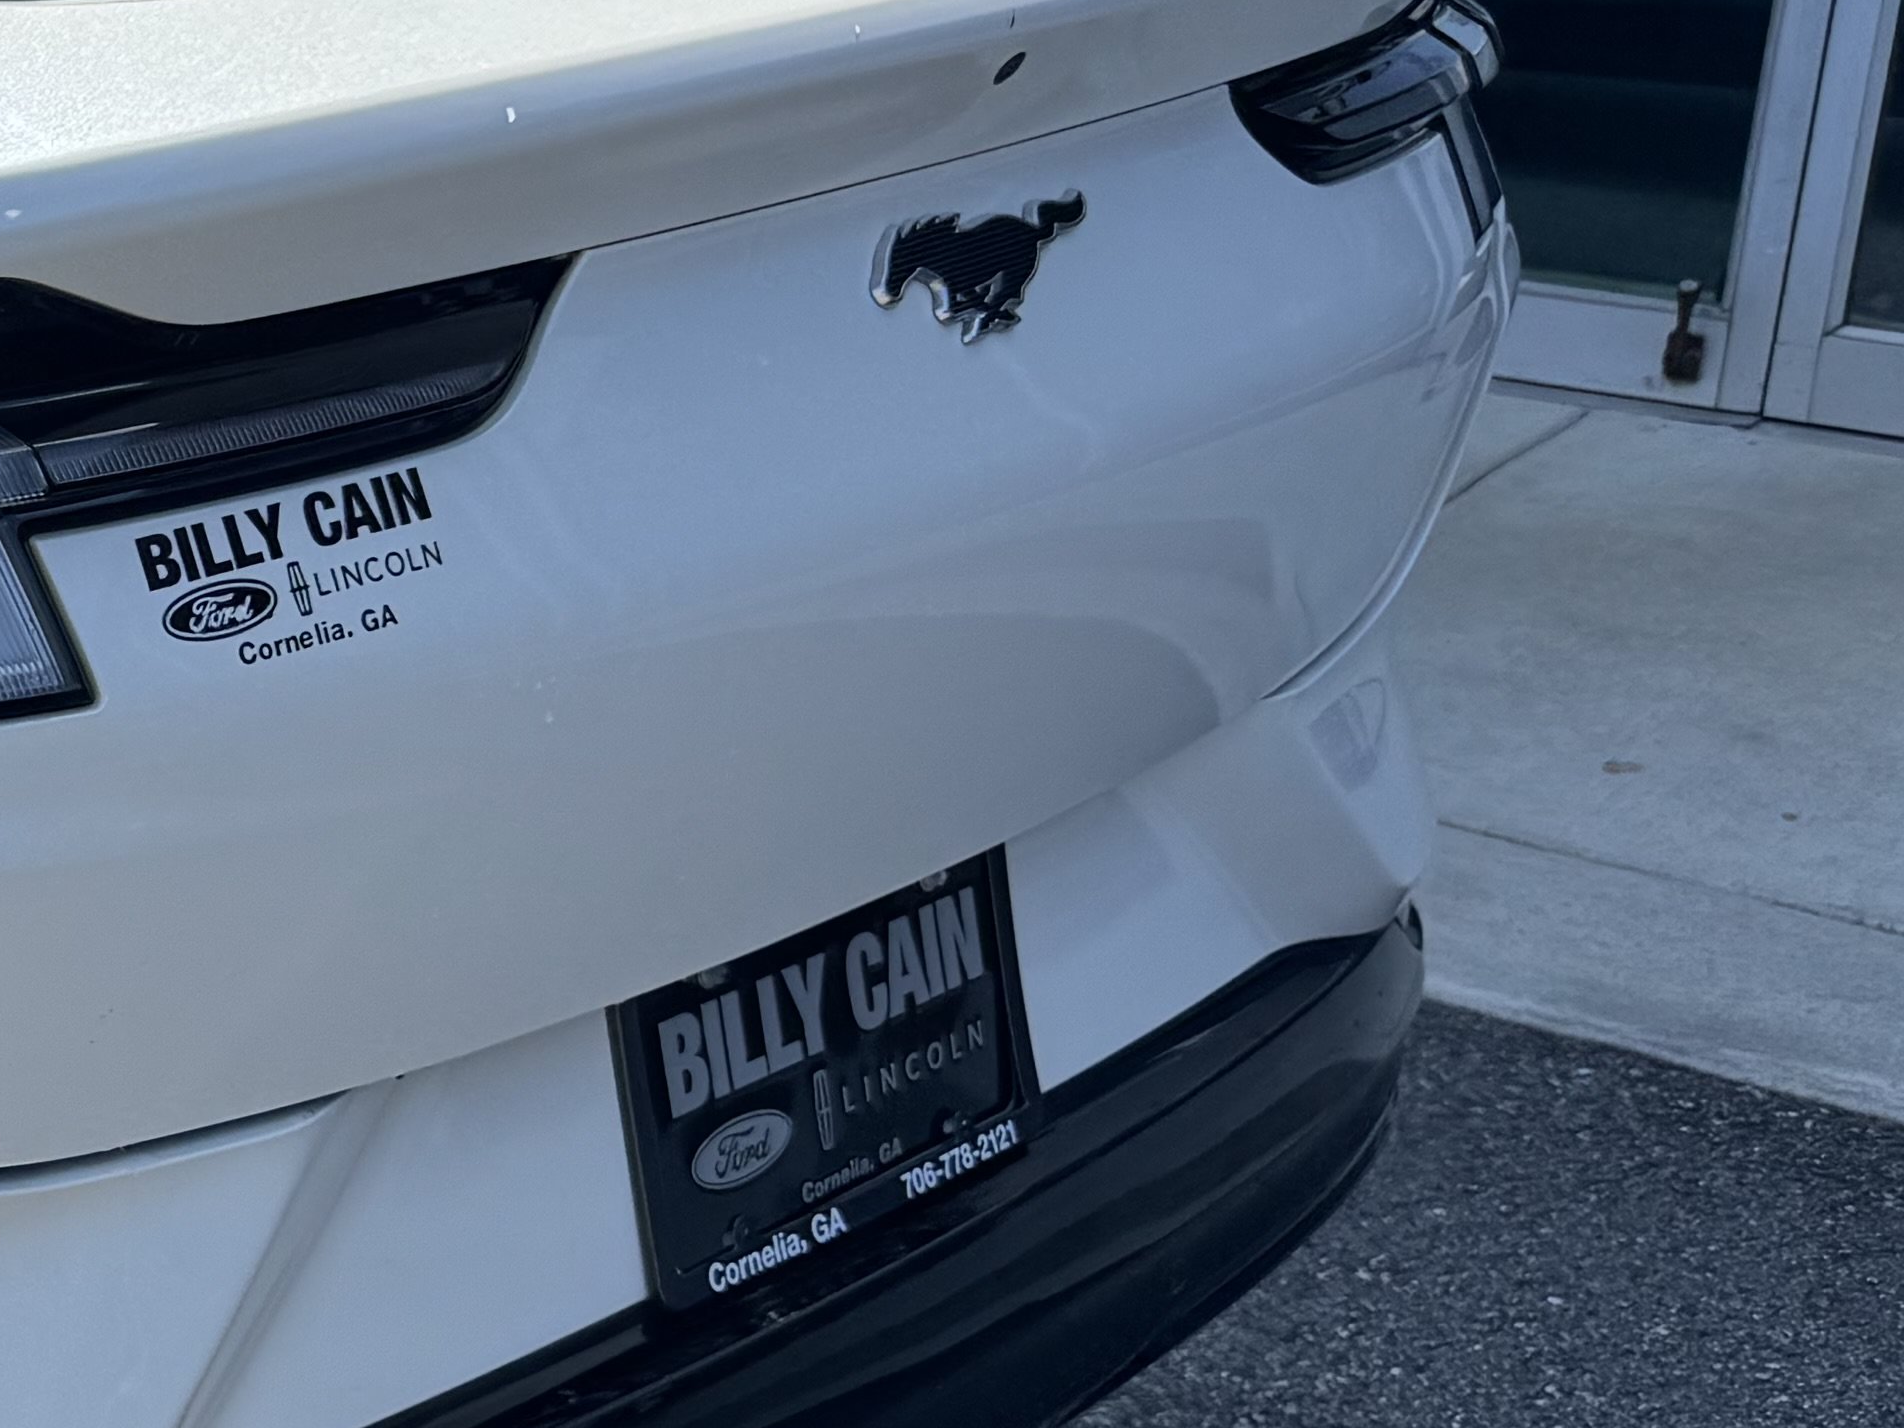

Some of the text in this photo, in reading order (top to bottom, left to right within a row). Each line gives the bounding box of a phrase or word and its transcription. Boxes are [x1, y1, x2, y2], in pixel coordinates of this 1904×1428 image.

[134, 467, 433, 592] BILLY CAIN
[311, 541, 444, 597] LINCOLN
[360, 604, 399, 633] GA
[657, 885, 986, 1120] BILLY CAIN
[841, 1018, 986, 1114] LINCOLN
[878, 1136, 903, 1165] GA
[708, 1119, 1019, 1294] Cornelia, GA 706-778-2121
